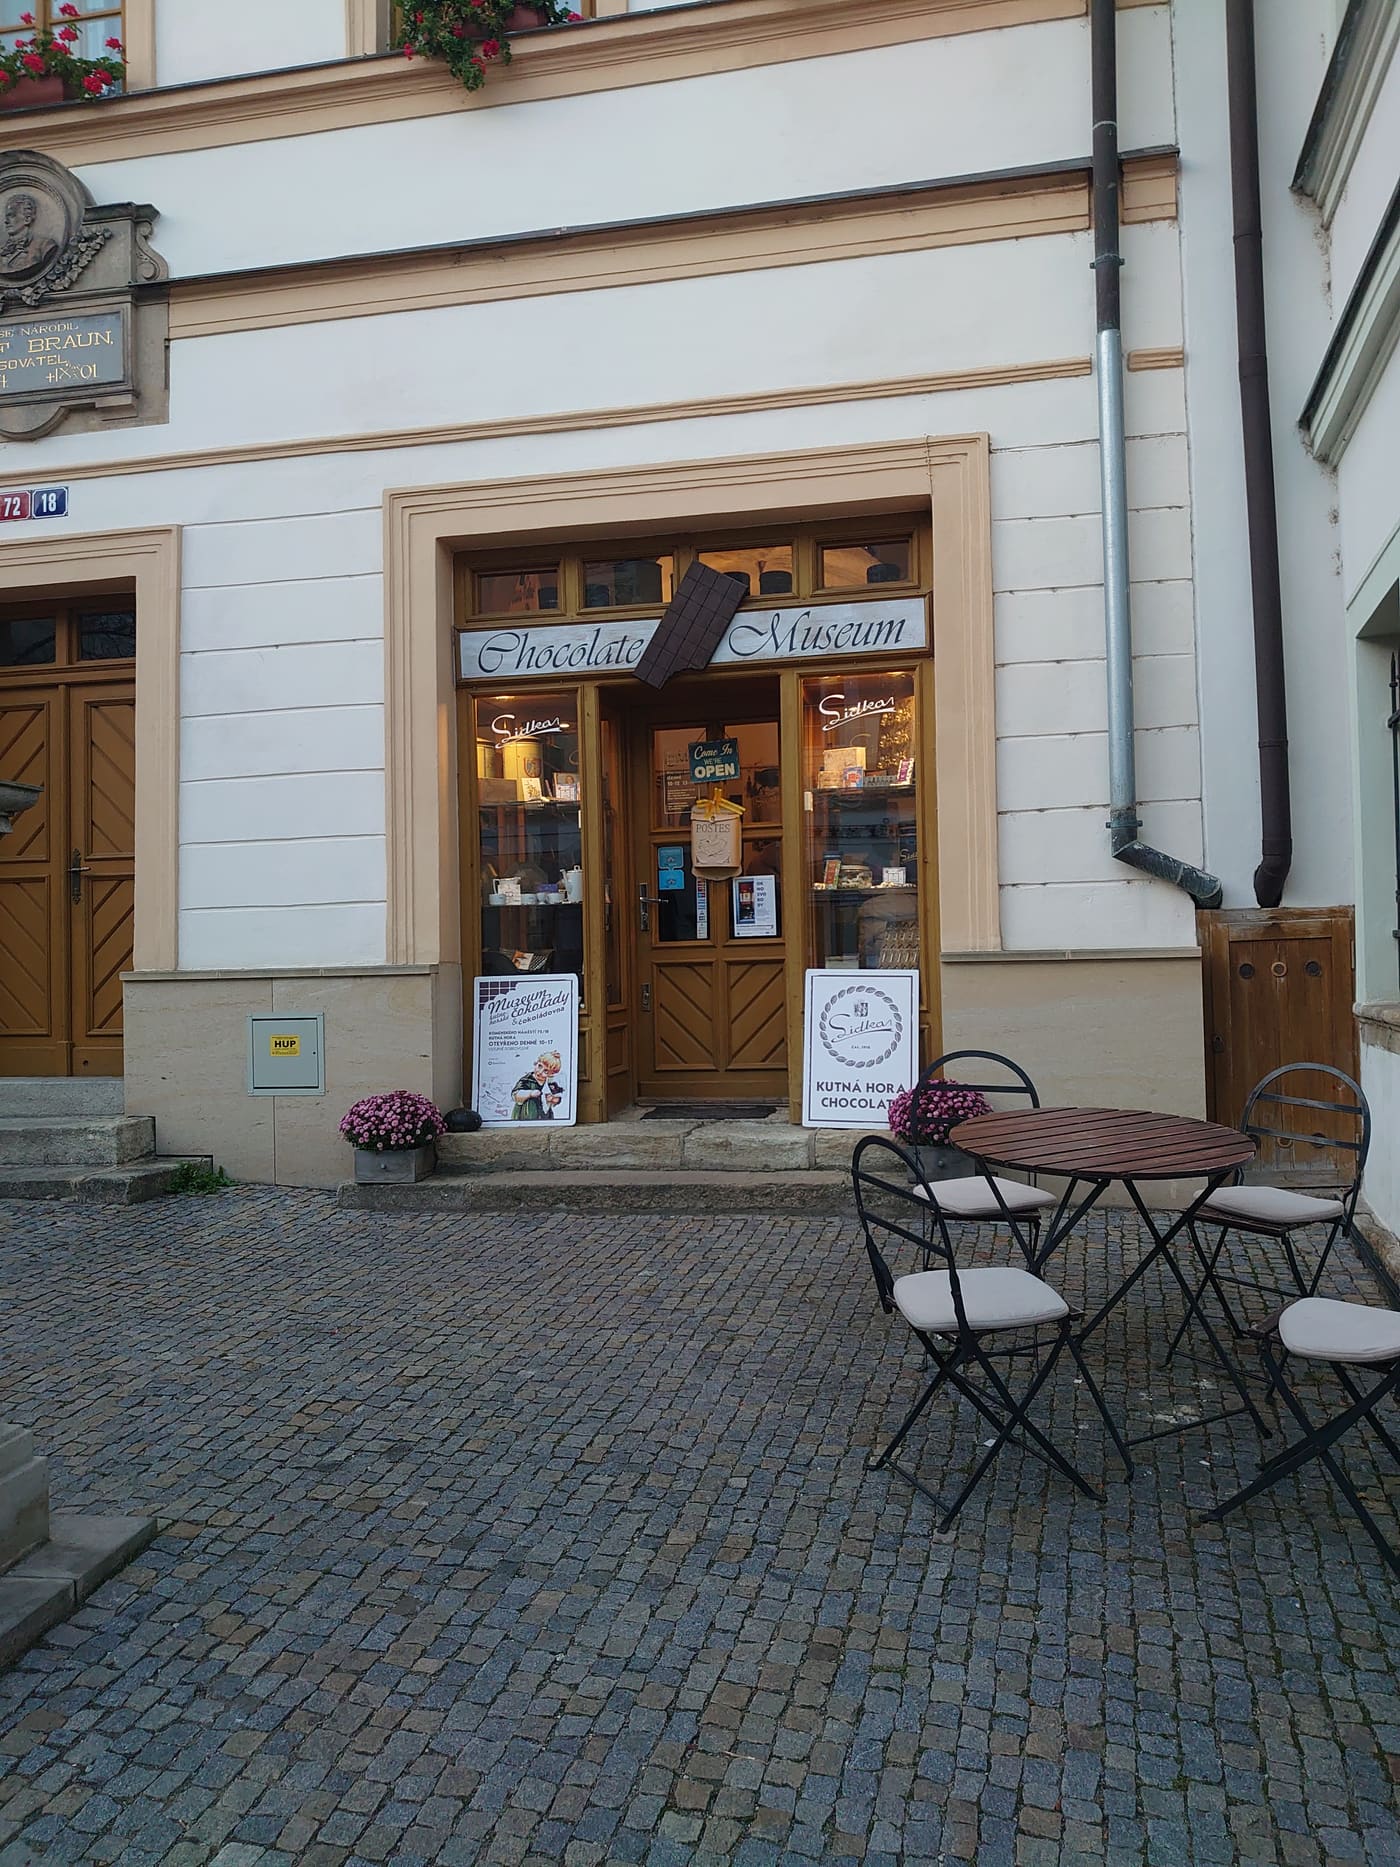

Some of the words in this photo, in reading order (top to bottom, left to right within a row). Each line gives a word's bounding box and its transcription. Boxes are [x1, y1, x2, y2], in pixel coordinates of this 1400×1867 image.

[4, 496, 21, 517] 72
[41, 492, 57, 513] 18
[477, 627, 645, 674] Chocolate
[728, 611, 907, 657] Museum
[694, 745, 718, 760] Come
[720, 743, 733, 756] In
[694, 762, 735, 779] OPEN
[695, 823, 731, 833] POSTES
[487, 989, 551, 1014] Muzeum
[274, 1040, 296, 1048] HUP
[816, 1080, 861, 1093] KUTNÁ
[866, 1082, 906, 1094] HORA
